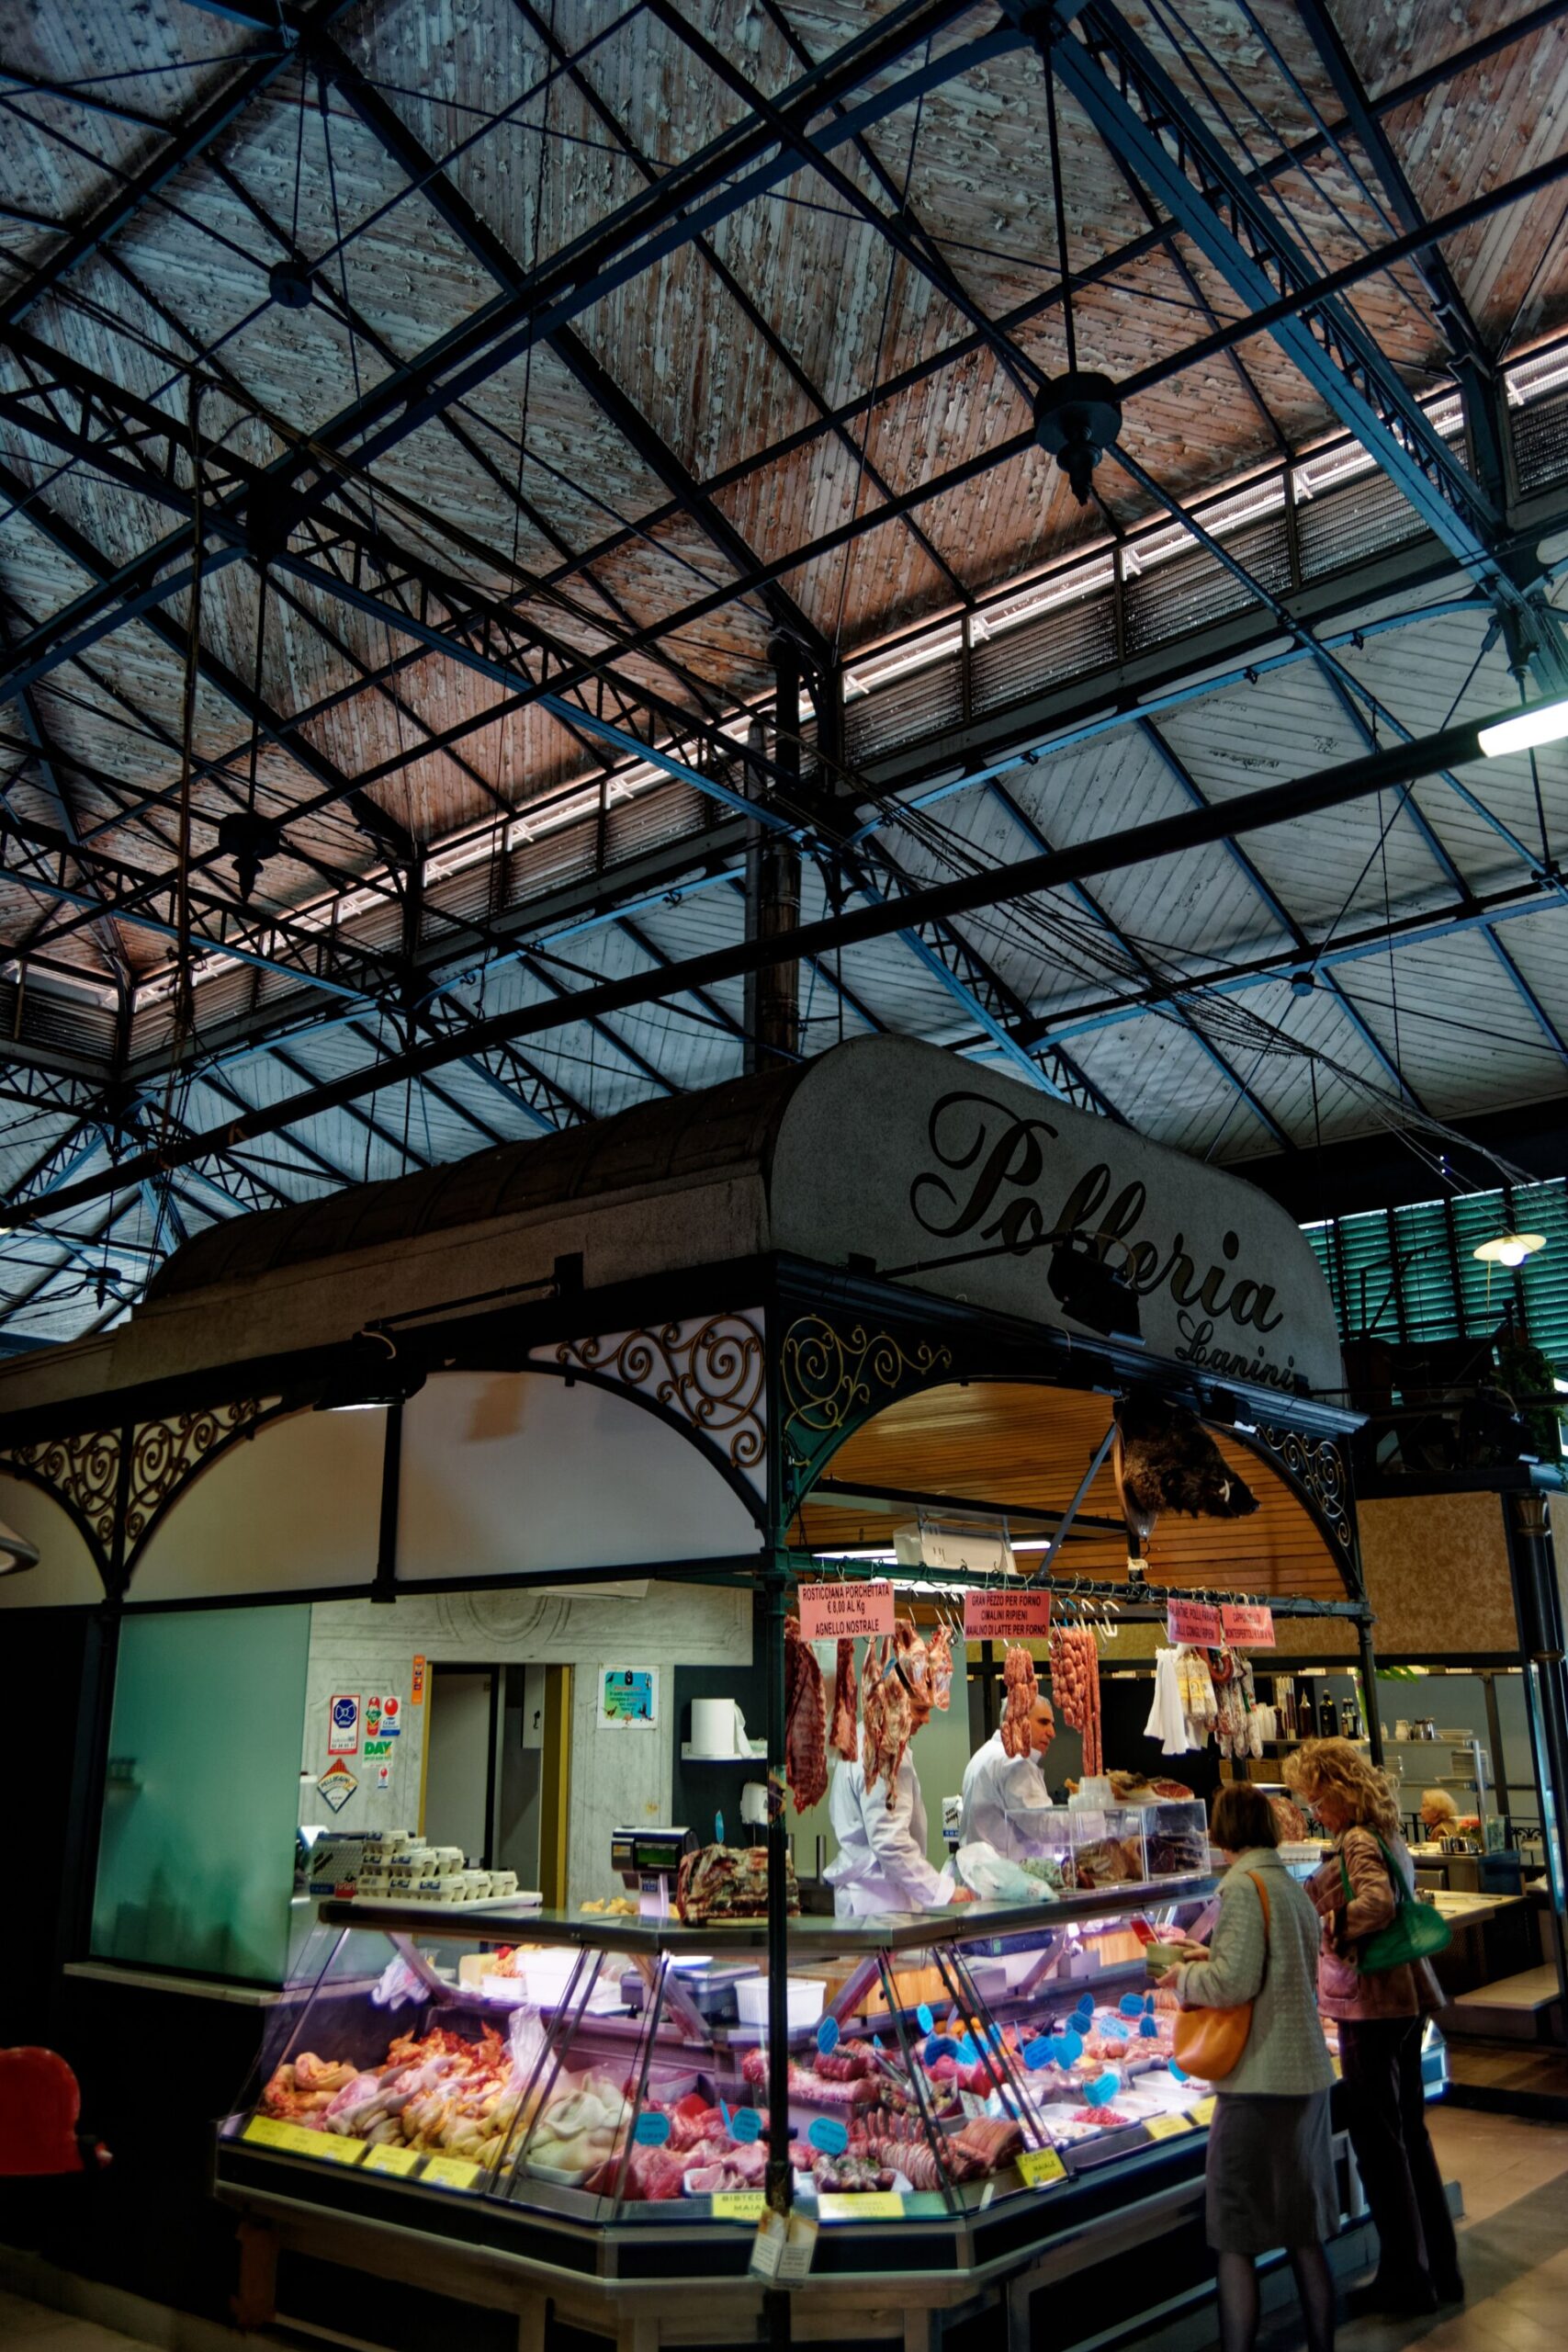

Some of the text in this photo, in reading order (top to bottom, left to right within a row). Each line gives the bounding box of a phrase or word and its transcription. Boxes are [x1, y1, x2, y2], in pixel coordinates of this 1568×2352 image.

[910, 1091, 1283, 1332] Polleria
[1175, 1309, 1292, 1390] Lanini
[802, 1584, 889, 1600] ROSTICCIANA PORCHETTATA
[827, 1599, 865, 1615] € 8,00 AL Kg
[987, 1595, 1004, 1606] PEZZO
[1005, 1595, 1018, 1606] PER
[1019, 1595, 1042, 1607] FORNO
[1006, 1610, 1028, 1621] RIPIENI
[816, 1619, 879, 1636] AGNELLO NOSTRALE
[994, 1624, 1012, 1635] LATTE
[1012, 1624, 1025, 1635] PER
[1026, 1624, 1046, 1635] FORNO
[364, 1741, 392, 1755] DAY
